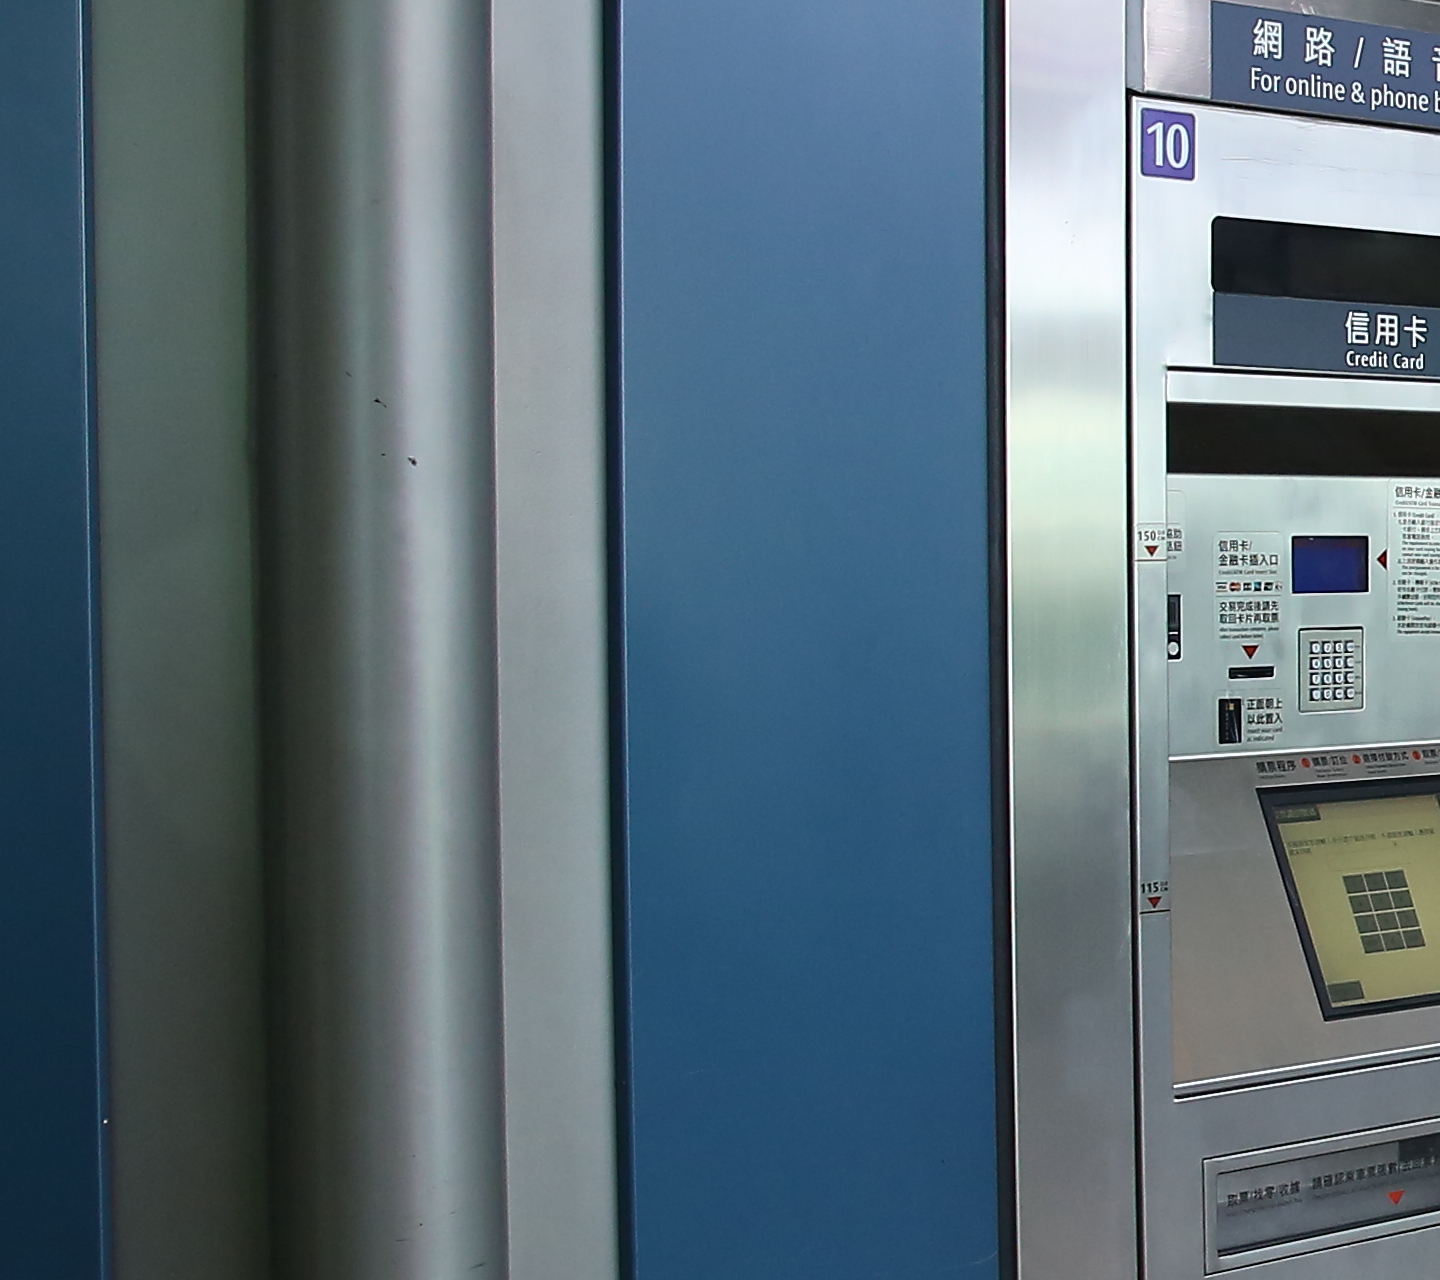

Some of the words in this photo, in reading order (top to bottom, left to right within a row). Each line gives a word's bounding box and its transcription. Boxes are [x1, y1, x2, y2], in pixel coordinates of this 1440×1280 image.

[1249, 66, 1281, 95] For
[1284, 70, 1346, 102] online
[1350, 80, 1366, 106] &
[1370, 84, 1430, 119] phone
[1146, 121, 1190, 171] 10
[1344, 310, 1428, 349] 信用卡
[1345, 348, 1389, 370] Credit
[1393, 351, 1425, 372] Card
[1137, 529, 1157, 542] 150
[1140, 881, 1159, 894] 115
